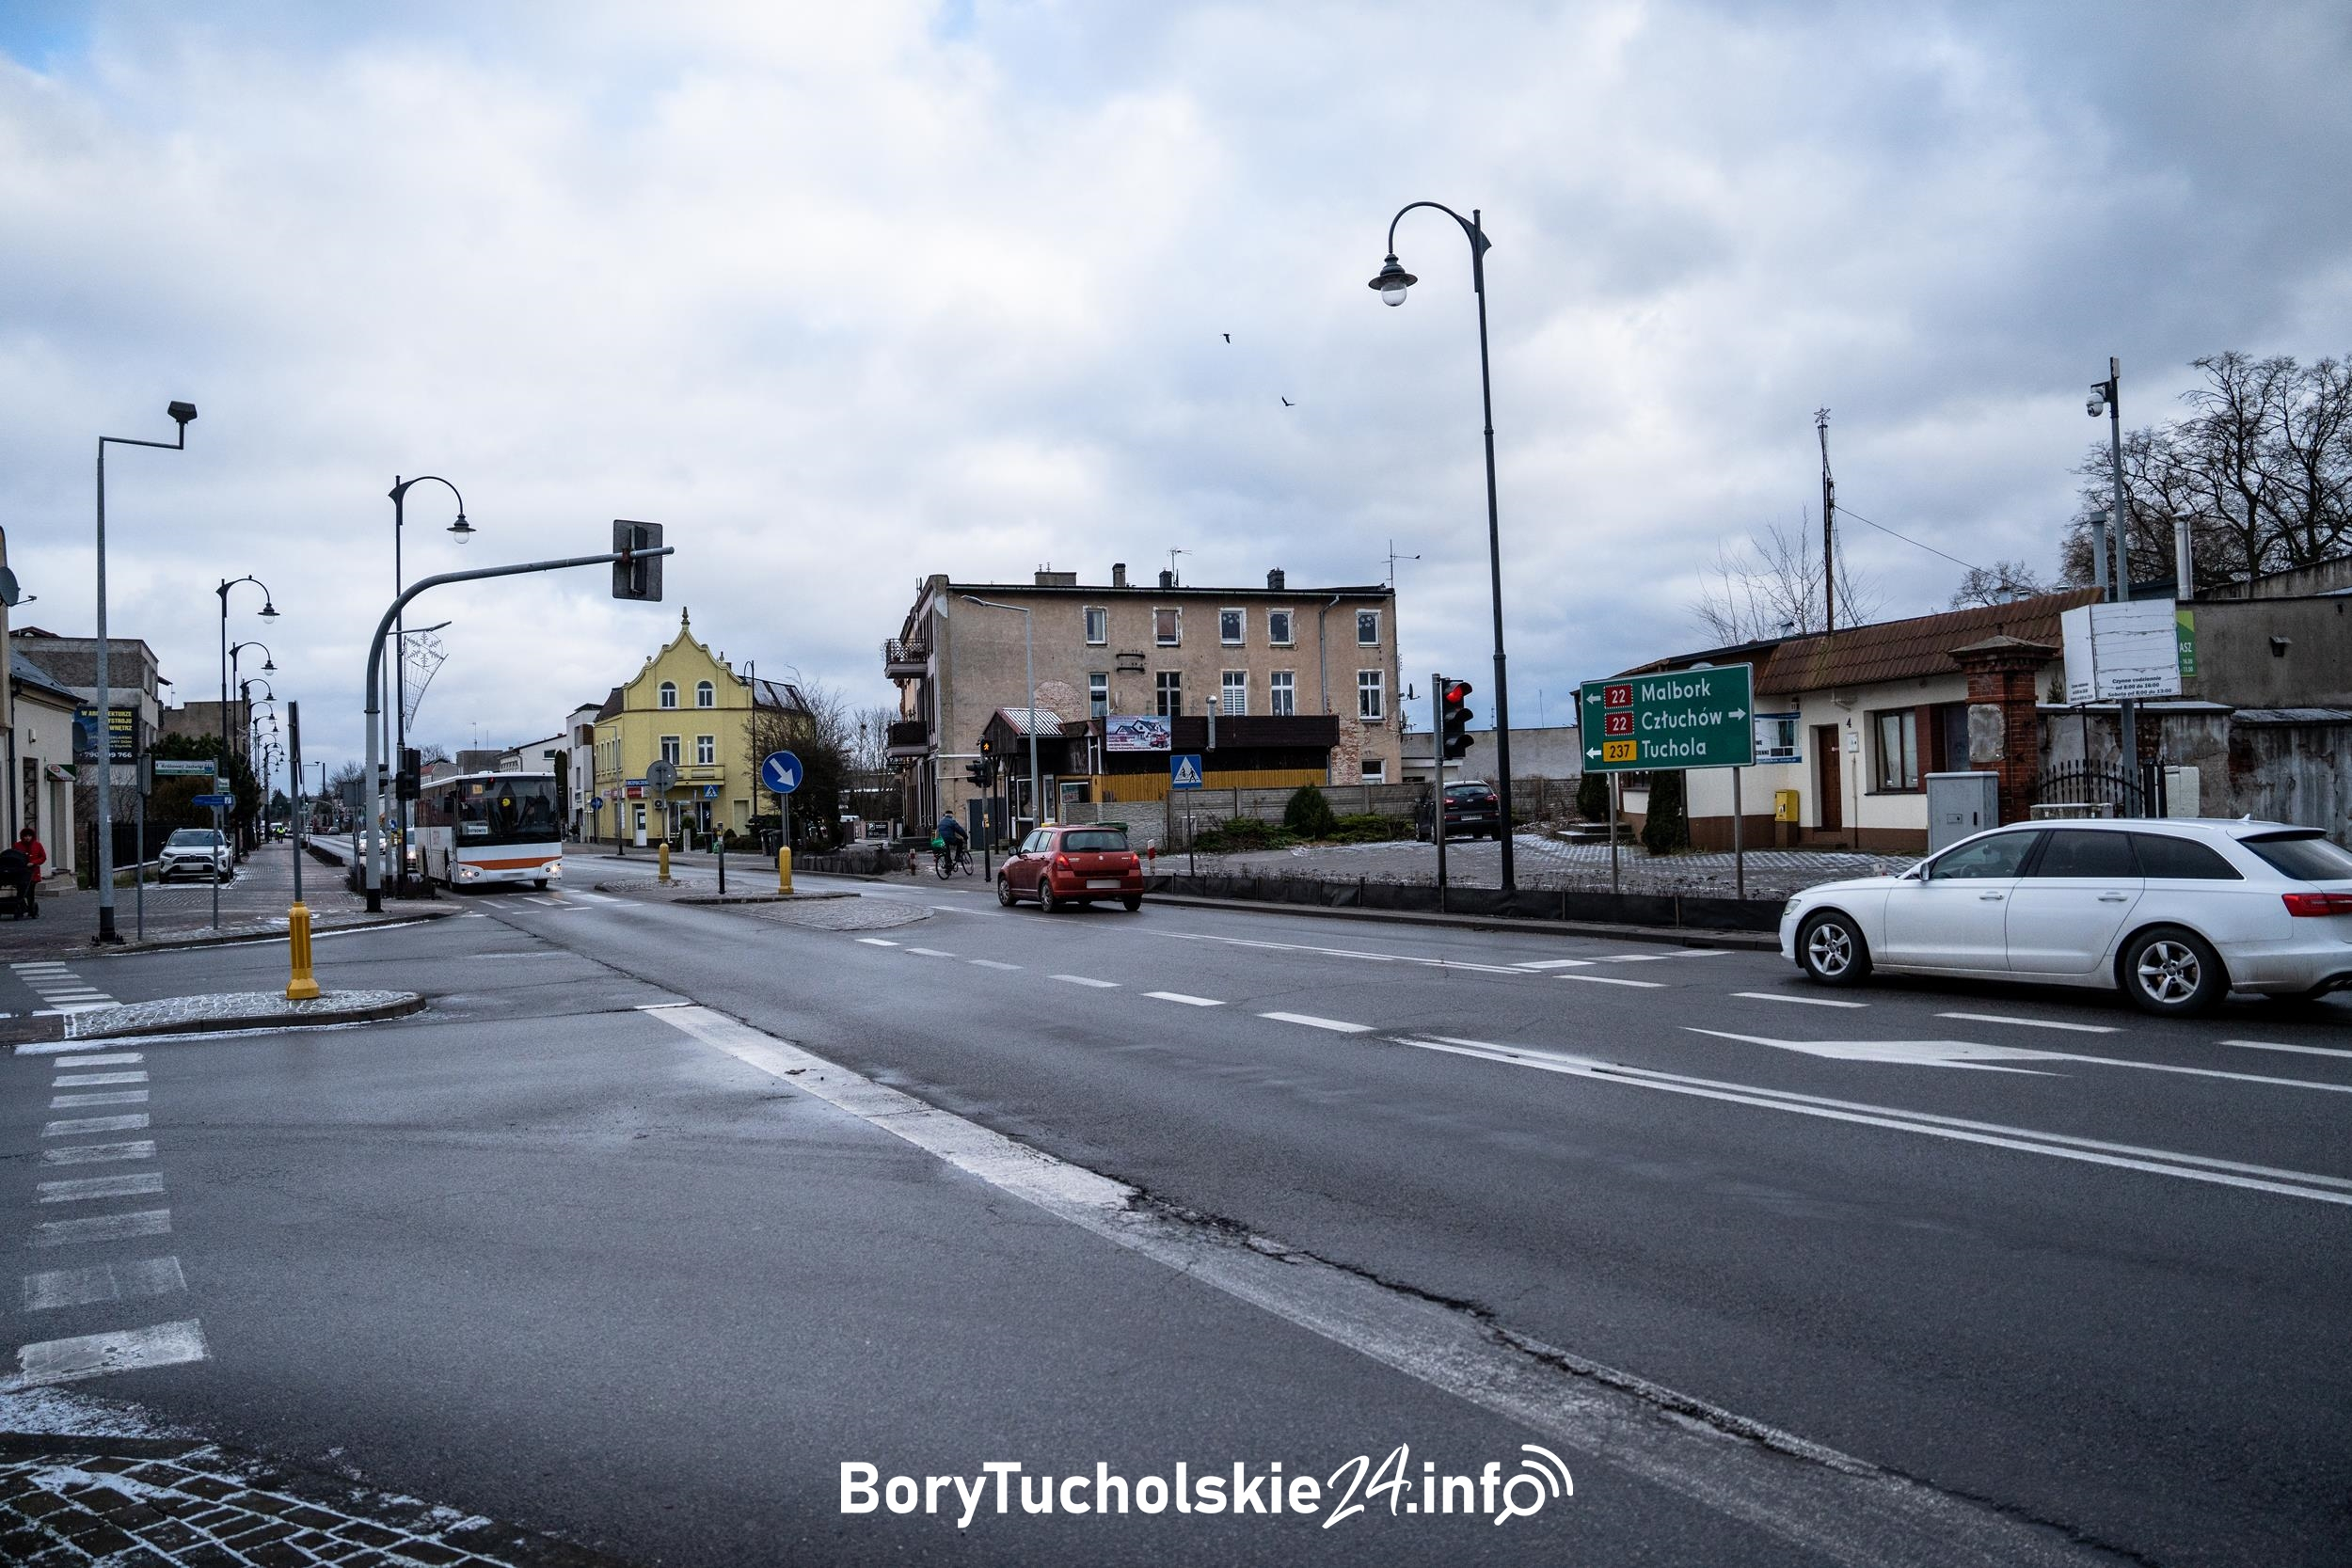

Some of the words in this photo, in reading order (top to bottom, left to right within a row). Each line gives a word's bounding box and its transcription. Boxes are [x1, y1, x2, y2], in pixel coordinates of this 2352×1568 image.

[1612, 689, 1626, 704] 22
[1642, 678, 1710, 702] Malbork
[1613, 717, 1627, 731] 22
[1642, 707, 1723, 730] Człuchów
[1846, 718, 1851, 728] 4
[1610, 745, 1630, 758] 237
[1642, 737, 1707, 758] Tuchola
